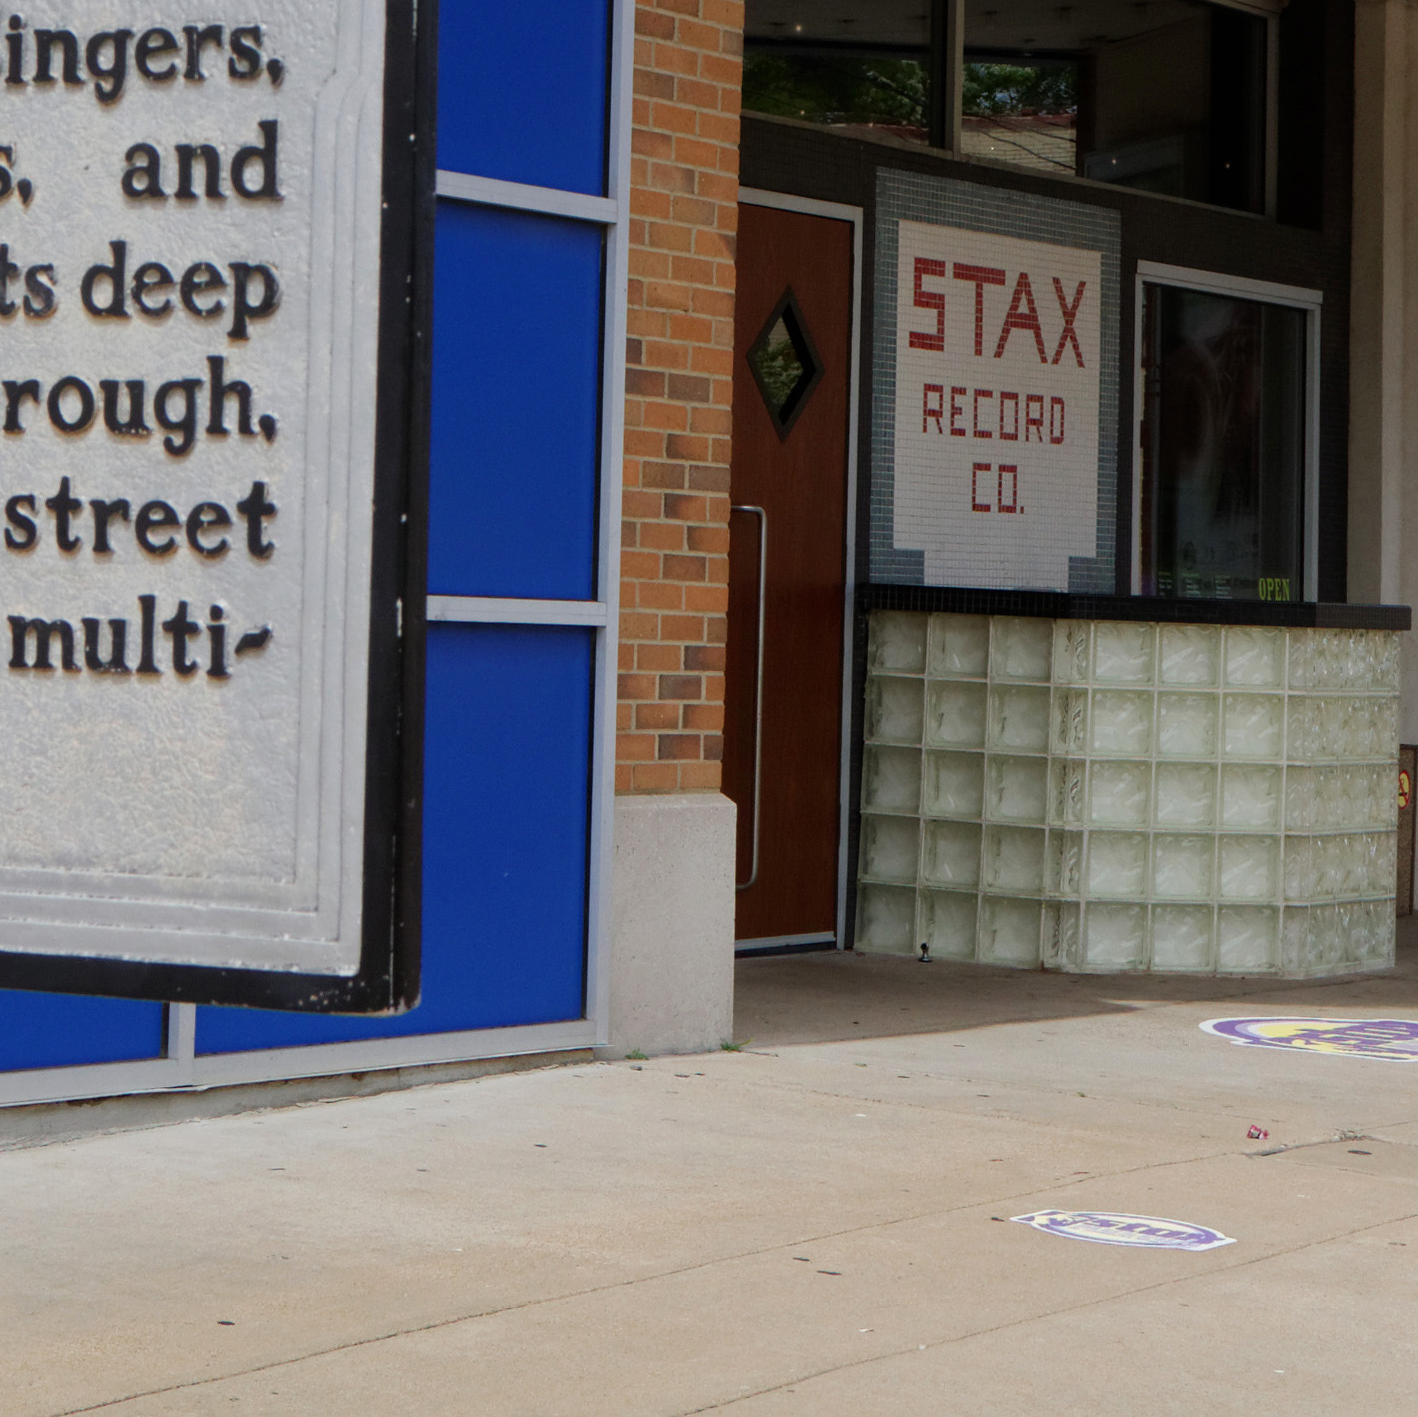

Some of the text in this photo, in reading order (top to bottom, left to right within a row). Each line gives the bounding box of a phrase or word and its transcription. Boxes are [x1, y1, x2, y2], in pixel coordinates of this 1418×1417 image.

[121, 120, 284, 201] and
[81, 241, 280, 338] deep
[908, 256, 1087, 368] STAX
[922, 383, 1065, 445] RECORD
[971, 462, 1024, 515] CO.
[1258, 577, 1290, 601] OPEN
[8, 594, 274, 679] multi-
